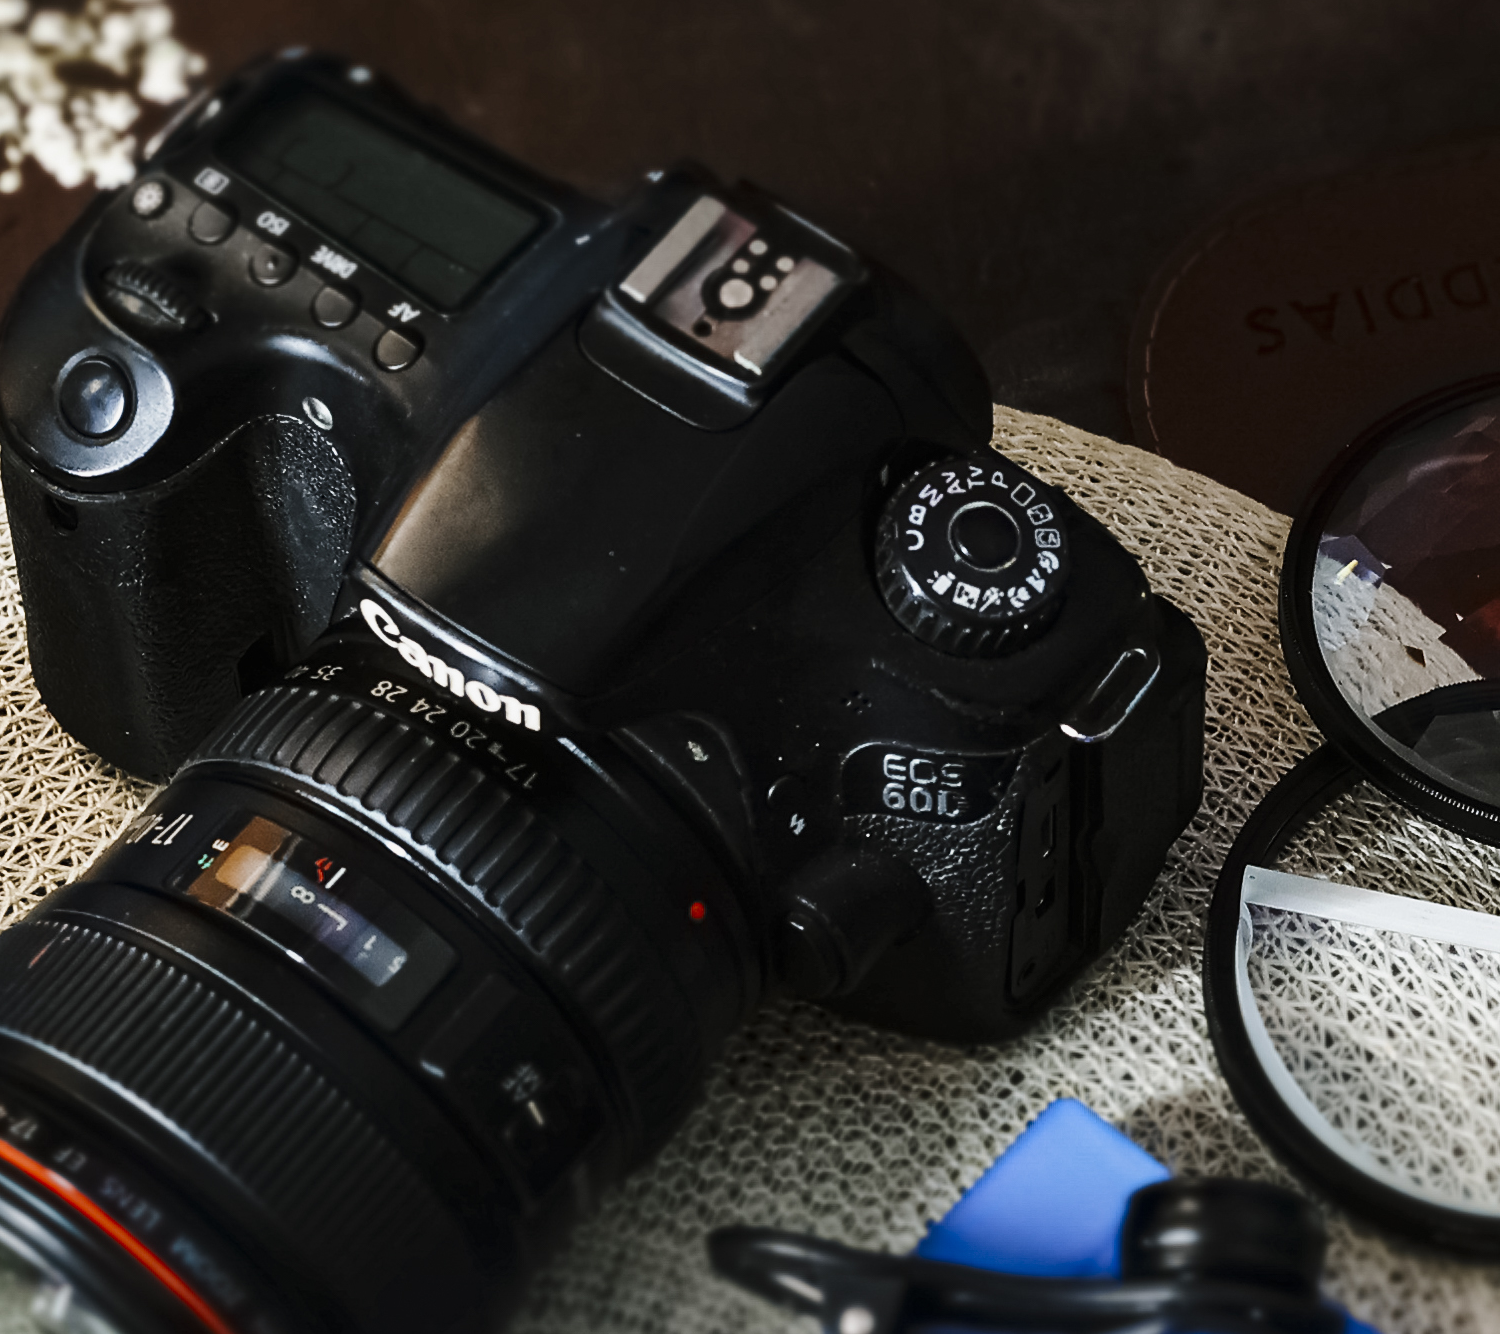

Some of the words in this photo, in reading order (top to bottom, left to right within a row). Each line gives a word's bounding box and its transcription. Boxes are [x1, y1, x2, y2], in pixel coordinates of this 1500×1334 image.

[256, 211, 290, 237] ISO
[309, 244, 358, 280] DRIVE
[387, 301, 421, 323] AF
[991, 471, 1008, 489] P
[918, 484, 943, 507] M
[908, 504, 927, 526] B
[905, 529, 924, 551] C
[310, 665, 343, 681] 35
[359, 598, 541, 732] Canon
[370, 680, 408, 703] 28
[409, 697, 447, 724] 24
[450, 721, 487, 749] 20
[504, 763, 538, 790] 17
[51, 1146, 89, 1174] EF
[98, 1175, 163, 1233] LENS
